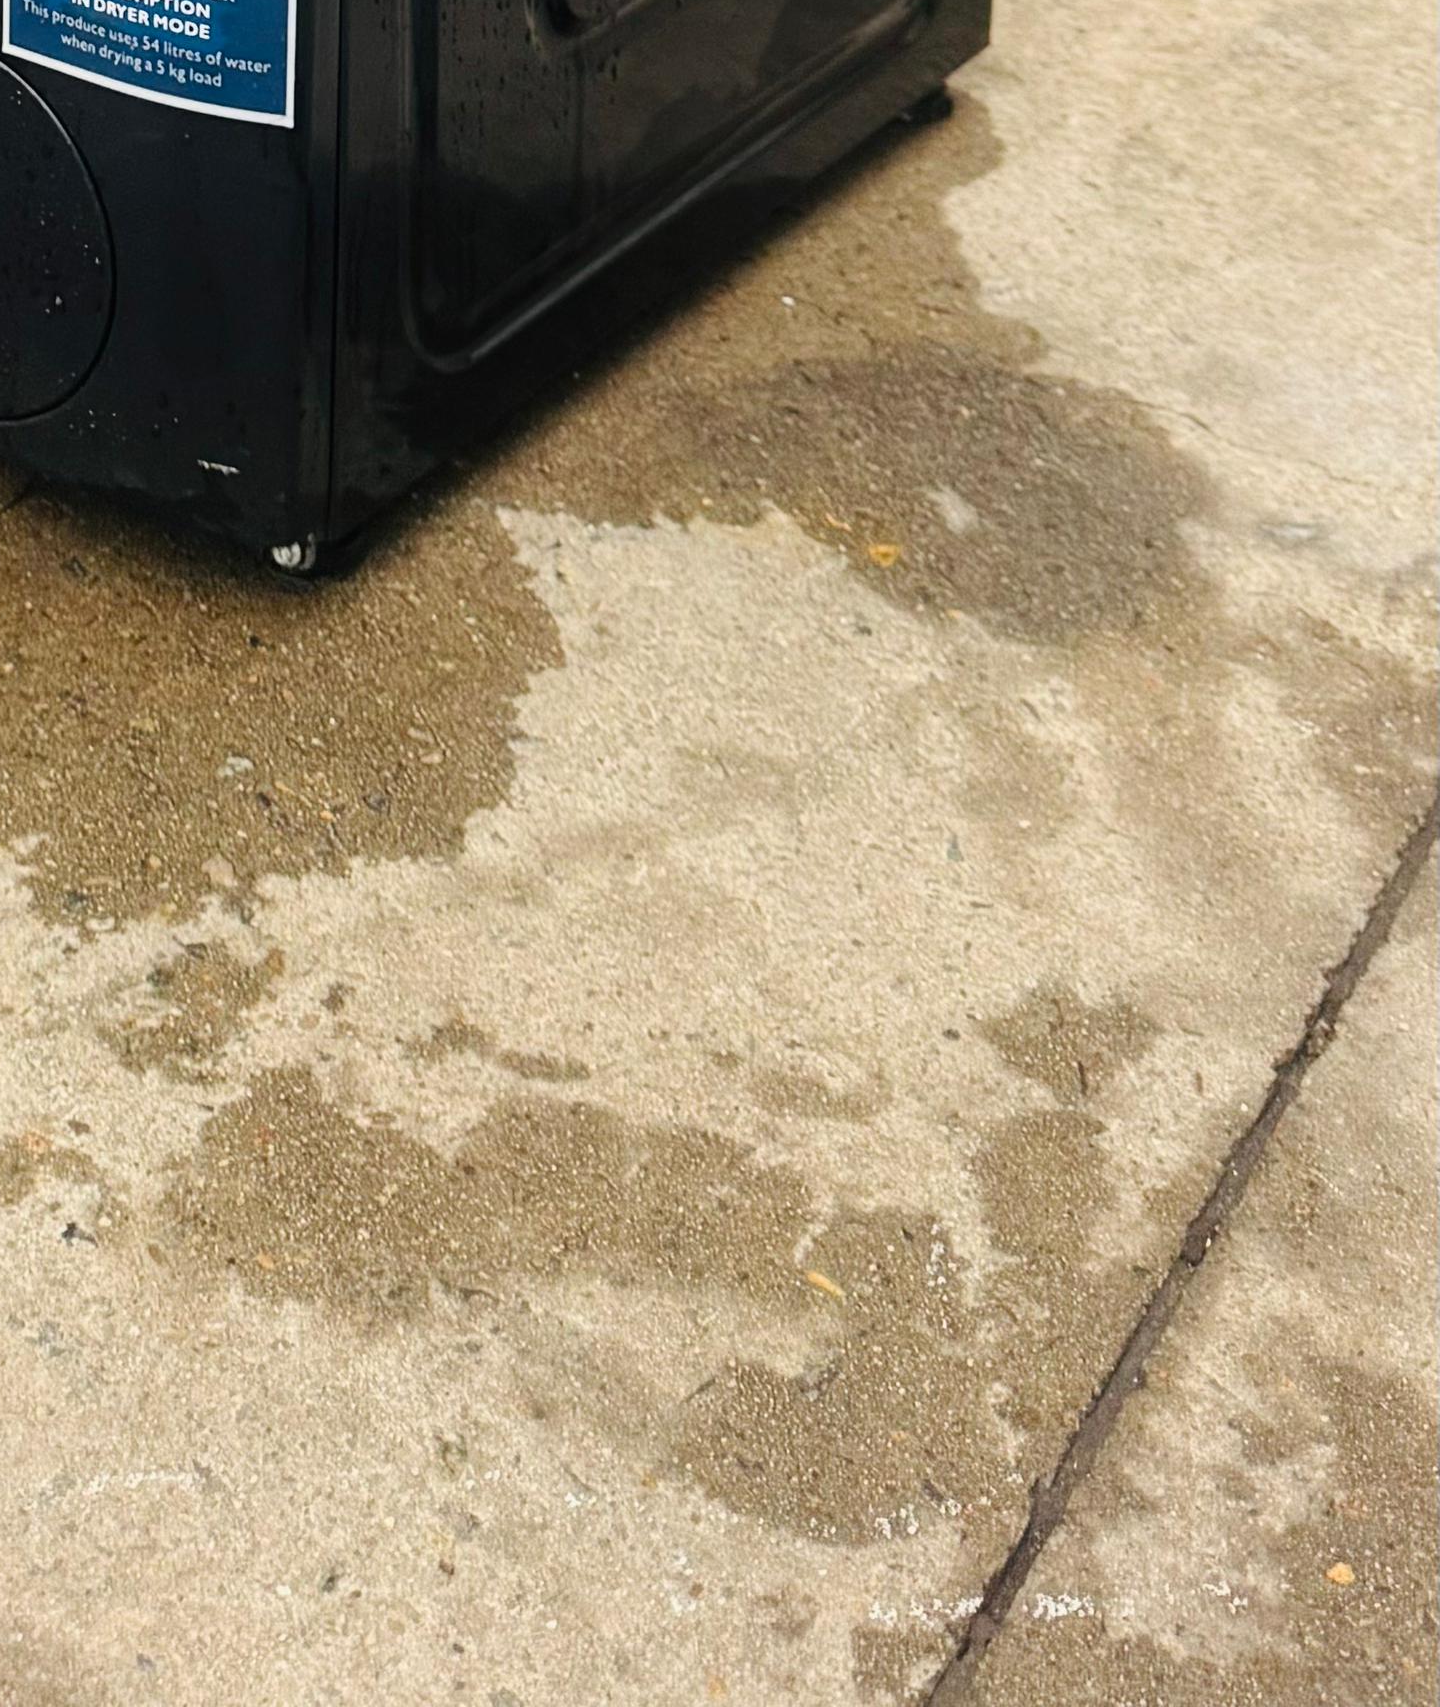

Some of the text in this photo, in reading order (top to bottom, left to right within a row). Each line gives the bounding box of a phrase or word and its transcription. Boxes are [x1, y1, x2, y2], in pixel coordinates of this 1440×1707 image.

[52, 9, 106, 38] produce
[109, 28, 139, 49] uses
[142, 35, 161, 53] 54
[163, 41, 202, 63] litres
[205, 50, 223, 67] of
[224, 55, 272, 75] water
[152, 13, 211, 40] MODE
[60, 33, 222, 88] when drying a 5 kg load
